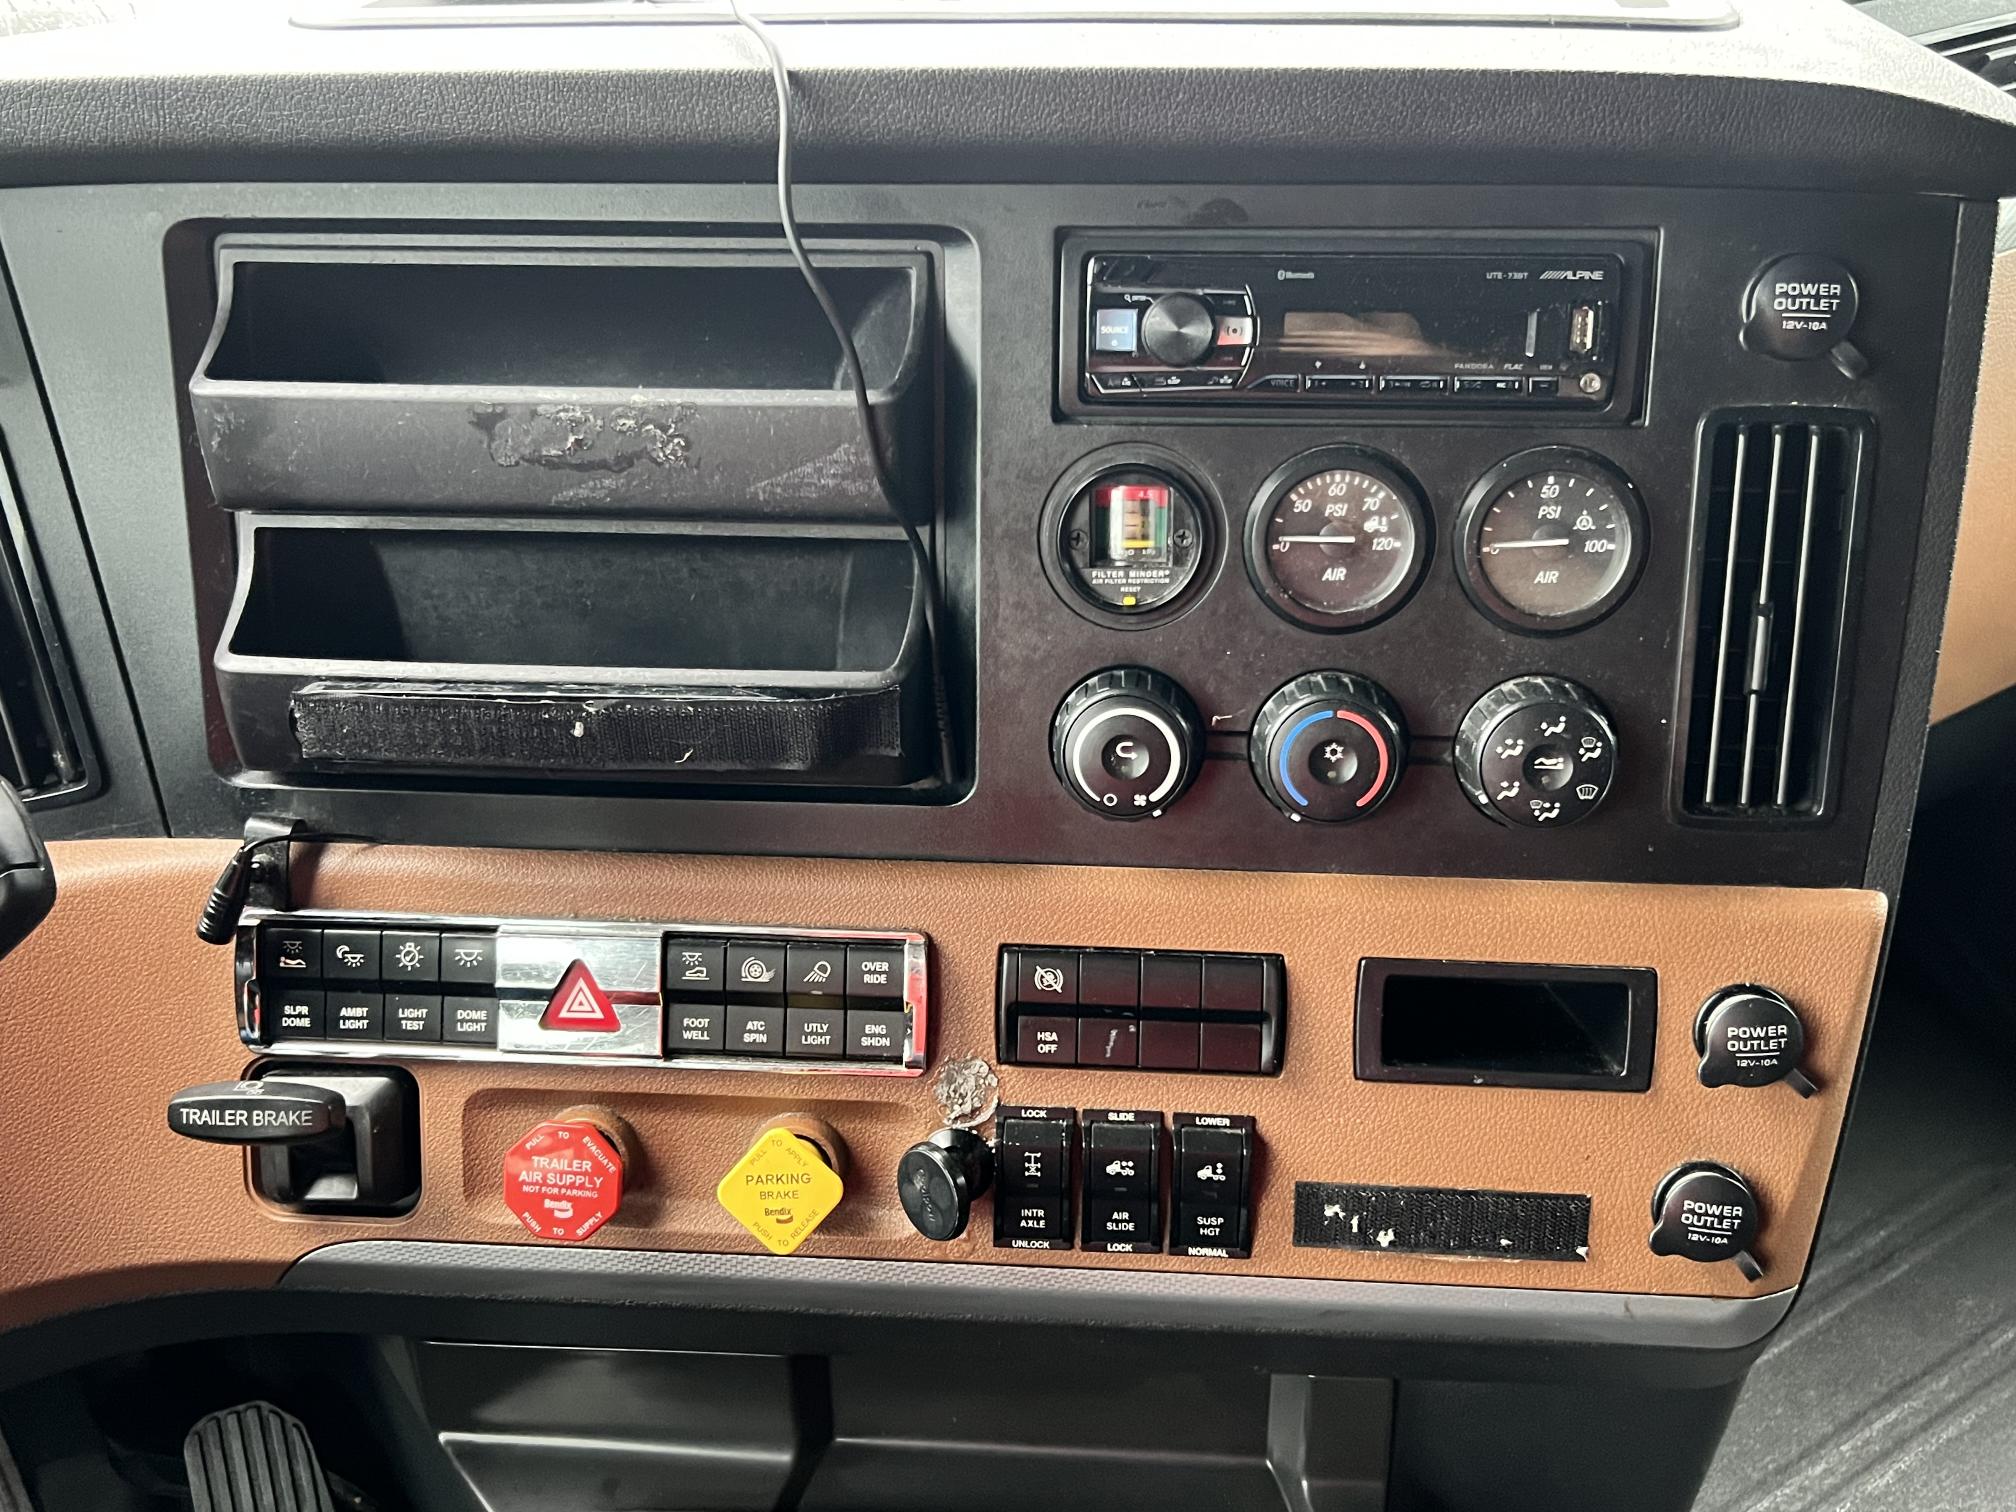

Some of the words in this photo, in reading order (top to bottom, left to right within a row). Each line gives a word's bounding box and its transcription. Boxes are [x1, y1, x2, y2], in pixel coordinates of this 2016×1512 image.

[1558, 270, 1604, 280] ALPINE
[1775, 283, 1841, 296] POWER
[1773, 297, 1841, 311] OUTLET
[1782, 320, 1828, 331] 12V-10A
[1328, 483, 1347, 496] 60
[1540, 484, 1560, 499] 50
[1293, 499, 1312, 512] 50
[1324, 503, 1349, 517] PSI
[1362, 498, 1380, 511] 70
[1537, 506, 1562, 519] PSI
[1372, 537, 1394, 551] 120
[1584, 540, 1608, 553] 100
[1092, 570, 1125, 578] FILTER
[1322, 567, 1347, 581] AIR
[1534, 571, 1560, 584] AIR
[861, 962, 889, 972] OVER
[863, 974, 887, 984] RIDE
[284, 1005, 309, 1016] SLPR
[340, 1007, 368, 1017] AMBT
[398, 1008, 428, 1018] LIGHT
[457, 1010, 487, 1020] DOME
[282, 1017, 311, 1028] DOME
[339, 1019, 369, 1030] LIGHT
[401, 1020, 424, 1030] TEST
[457, 1022, 487, 1032] LIGHT
[683, 1018, 710, 1028] FOOT
[746, 1021, 765, 1030] ATC
[804, 1023, 829, 1033] UTLY
[865, 1024, 886, 1034] ENG
[1727, 1024, 1787, 1038] POWER
[682, 1030, 710, 1041] WELL
[743, 1033, 767, 1043] SPIN
[801, 1035, 831, 1045] LIGHT
[1037, 1031, 1058, 1041] HSA
[861, 1036, 890, 1047] SHDN
[1727, 1038, 1788, 1051] OUTLET
[1037, 1043, 1058, 1053] OFF
[1736, 1058, 1778, 1067] 12V-10A
[180, 1108, 248, 1126] TRAILER
[252, 1110, 313, 1126] BRAKE
[1021, 1109, 1047, 1118] LOCK
[1108, 1112, 1135, 1121] SLIDE
[1195, 1116, 1230, 1126] LOWER
[525, 1134, 544, 1150] PULL
[558, 1131, 570, 1139] TO
[582, 1136, 616, 1174] EVACUATE
[750, 1149, 767, 1166] PULL
[771, 1139, 783, 1147] TO
[785, 1147, 809, 1168] APPLY
[531, 1156, 592, 1172] TRAILER
[518, 1170, 543, 1183] AIR
[546, 1173, 603, 1188] SUPPLY
[745, 1172, 812, 1186] PARKING
[522, 1185, 539, 1193] NOT
[542, 1186, 558, 1194] FOR
[561, 1188, 598, 1198] PARKING
[759, 1190, 799, 1200] BRAKE
[764, 1207, 792, 1217] Bendix
[1021, 1208, 1045, 1217] INTR
[1683, 1199, 1743, 1217] POWER
[1112, 1211, 1129, 1220] AIR
[1196, 1216, 1224, 1225] SUSP
[522, 1212, 542, 1233] PUSH
[552, 1227, 564, 1235] TO
[576, 1211, 603, 1236] SUPPLY
[1020, 1219, 1046, 1228] AXLE
[1106, 1222, 1135, 1231] SLIDE
[1681, 1213, 1741, 1230] OUTLET
[753, 1222, 774, 1241] PUSH
[777, 1239, 789, 1247] TO
[790, 1208, 819, 1239] RELEASE
[1199, 1227, 1220, 1236] HGT
[1687, 1232, 1729, 1244] 12V-10A
[1012, 1239, 1050, 1249] UNLOCK
[1107, 1243, 1133, 1252] LOCK
[1187, 1246, 1229, 1258] NORMAL
